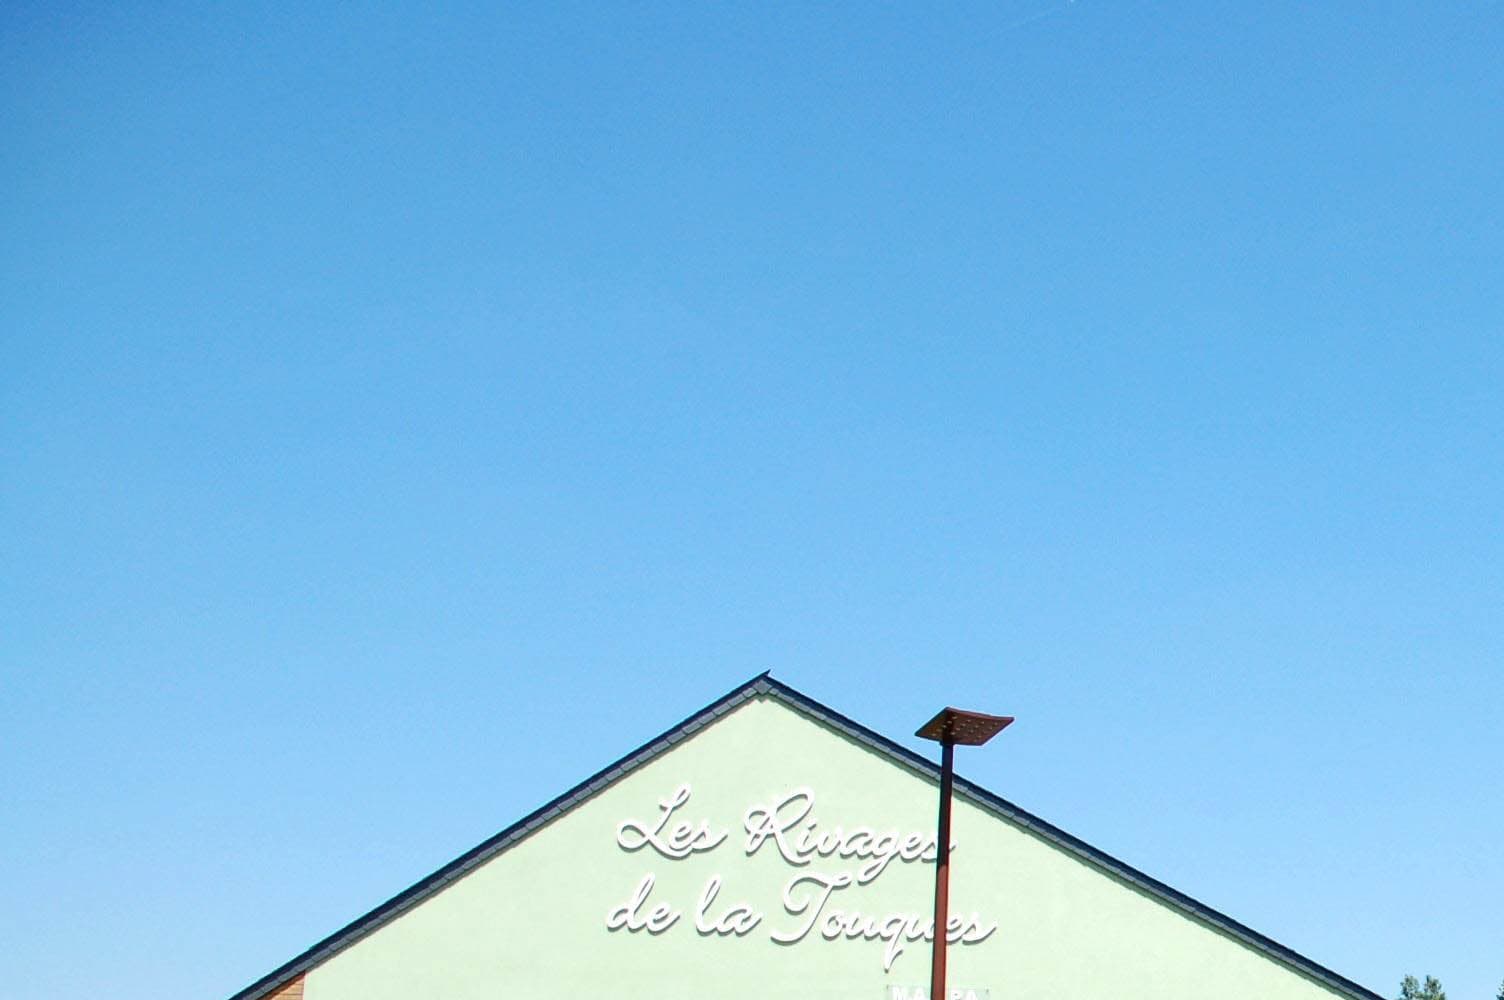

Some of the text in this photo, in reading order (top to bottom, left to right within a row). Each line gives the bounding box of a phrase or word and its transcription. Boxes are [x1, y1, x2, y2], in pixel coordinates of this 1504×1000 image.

[616, 784, 958, 884] Les Rivages
[606, 871, 998, 972] de la Touques
